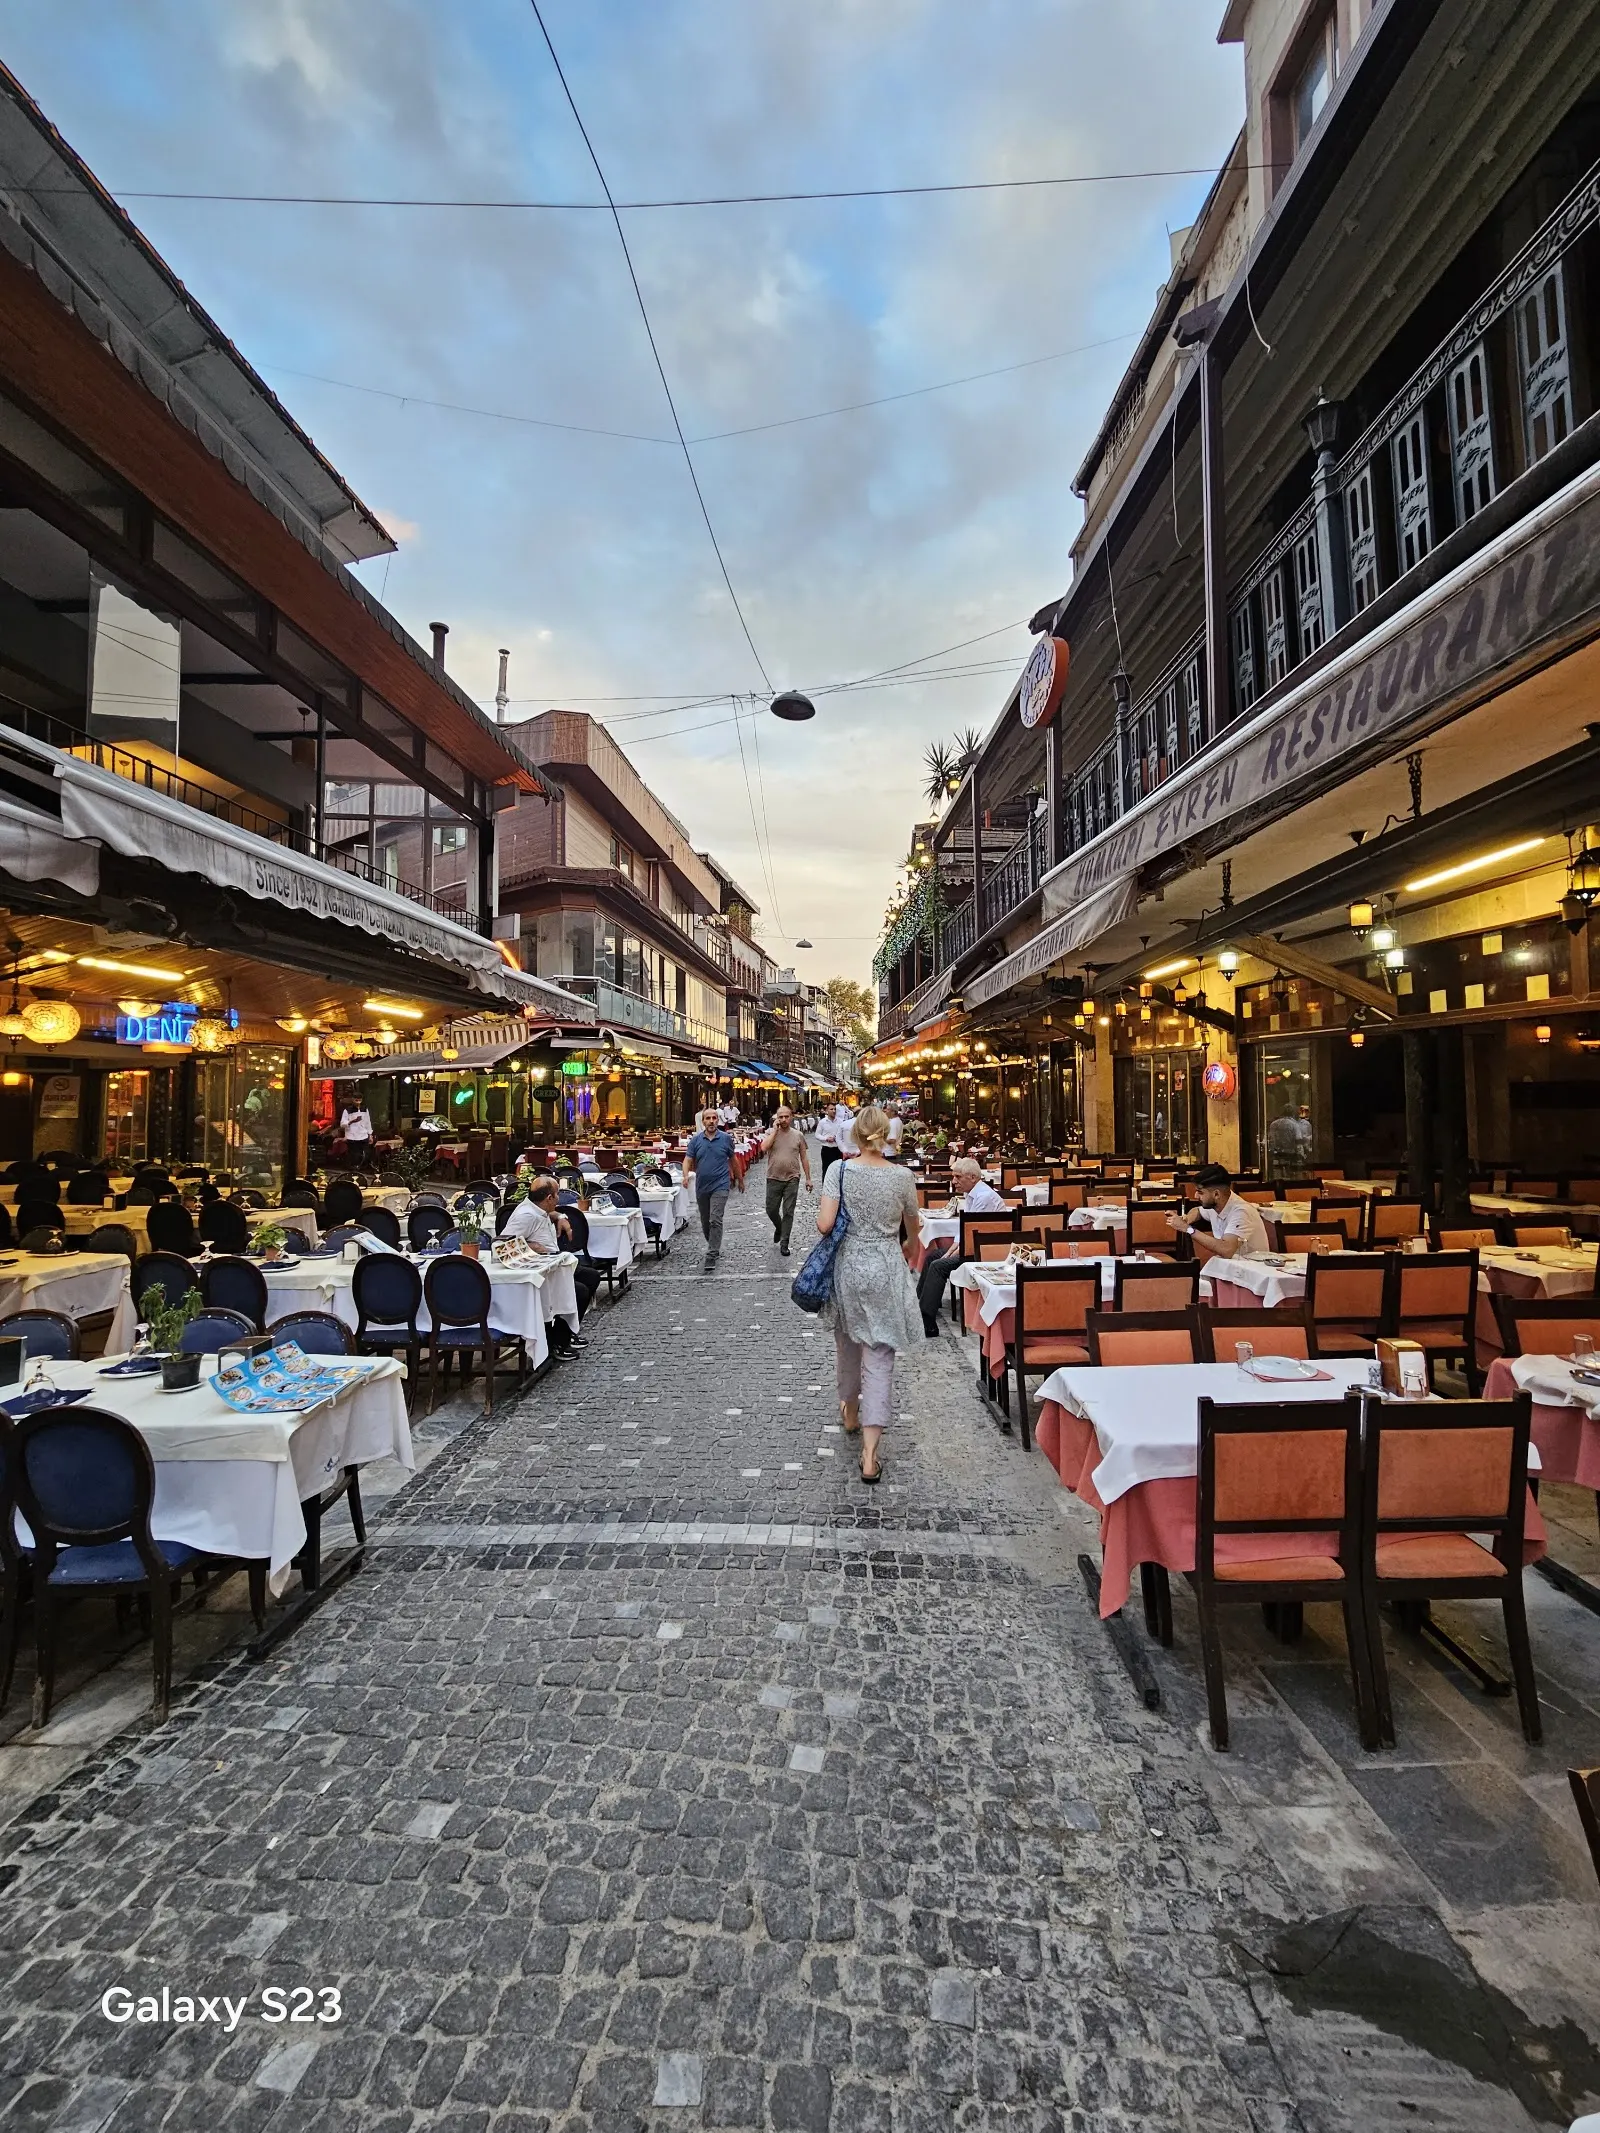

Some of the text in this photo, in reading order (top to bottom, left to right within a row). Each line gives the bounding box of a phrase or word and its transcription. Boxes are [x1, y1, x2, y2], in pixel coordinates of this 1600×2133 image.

[1154, 758, 1239, 848] EVREN
[1261, 524, 1580, 784] RESTAURANT
[256, 861, 290, 898] Since
[294, 875, 319, 907] 1952
[1030, 922, 1074, 968] RESTAURANT
[535, 1089, 559, 1098] GREEN
